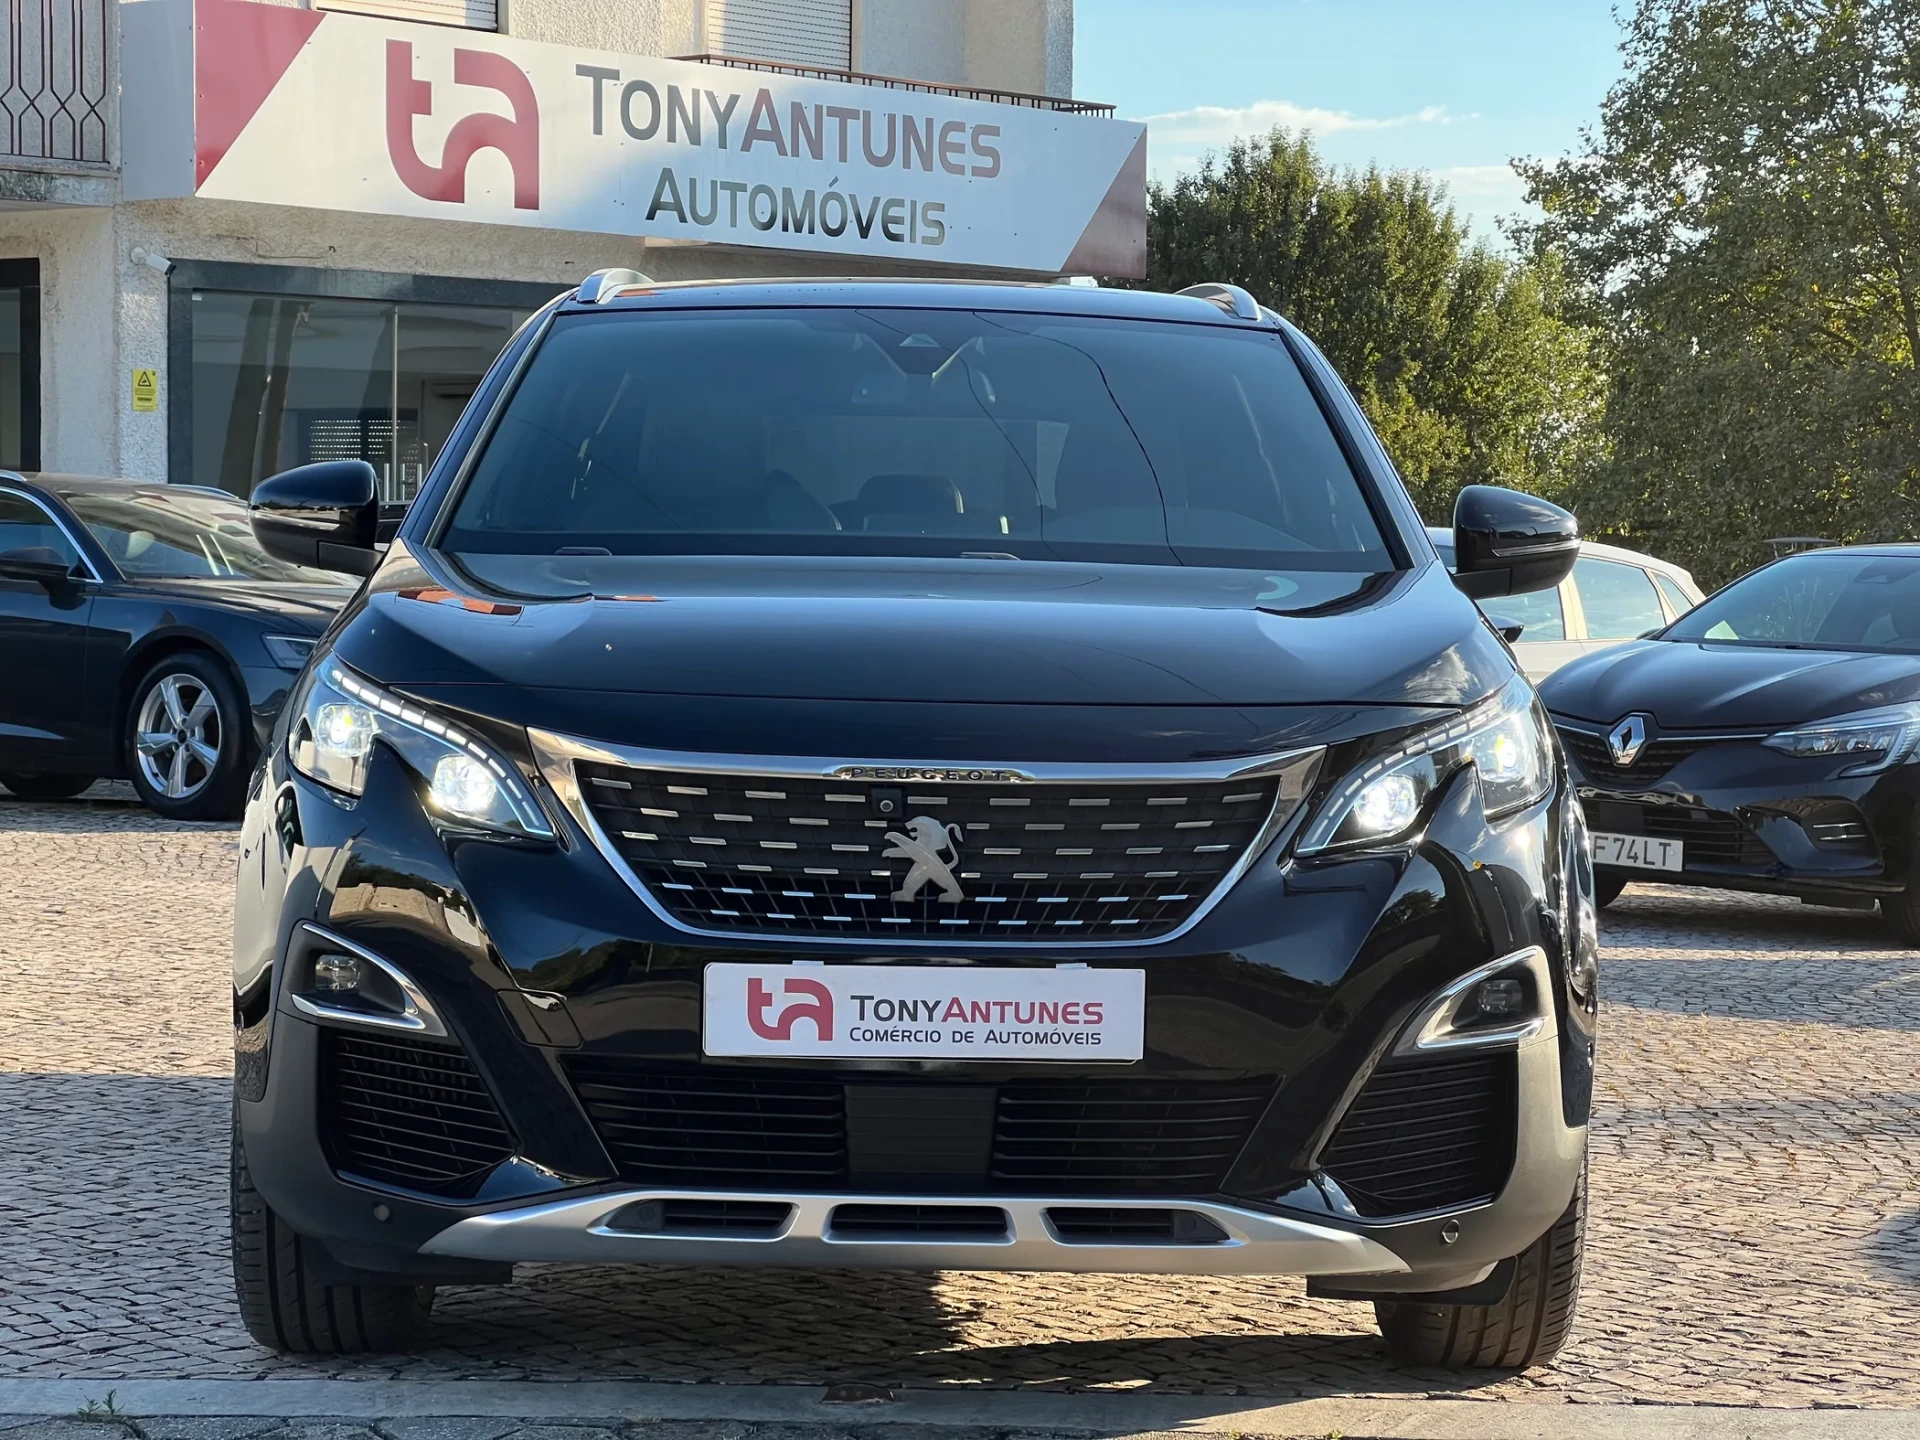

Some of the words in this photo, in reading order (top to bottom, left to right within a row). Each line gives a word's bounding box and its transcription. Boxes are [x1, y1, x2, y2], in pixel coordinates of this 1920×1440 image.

[646, 167, 947, 246] AUTOMÓVEIS
[850, 767, 1006, 781] PEUGEOT
[849, 1026, 942, 1044] COMÉRCIO
[952, 1029, 974, 1044] DE
[984, 1028, 1102, 1046] AUTOMÓVEIS
